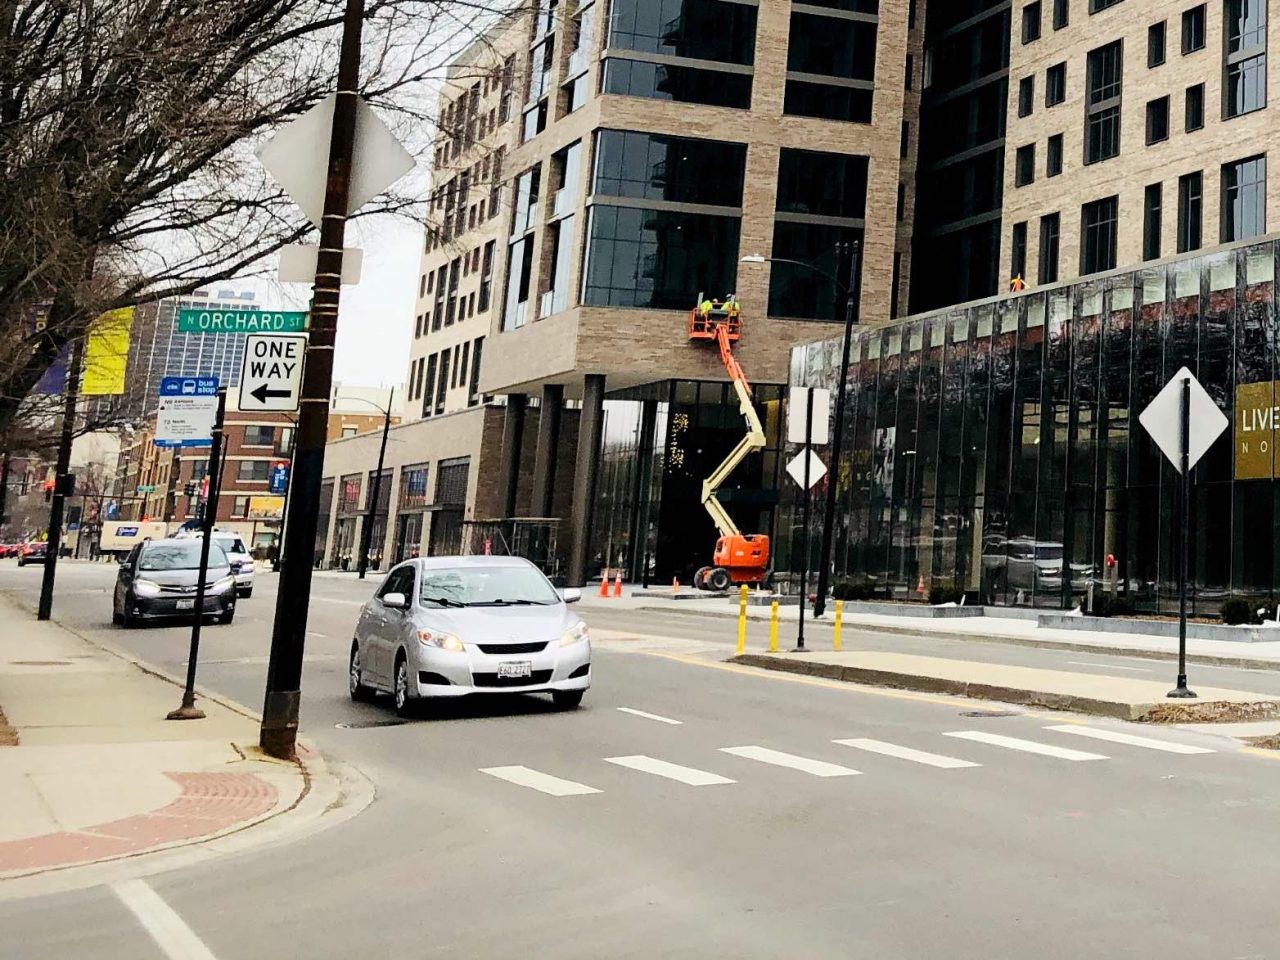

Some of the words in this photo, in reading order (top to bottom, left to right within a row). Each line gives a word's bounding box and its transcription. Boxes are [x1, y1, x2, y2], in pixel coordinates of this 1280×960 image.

[187, 315, 194, 325] N
[199, 312, 285, 330] ORCHARD
[289, 317, 300, 327] ST
[254, 340, 297, 359] ONE
[251, 361, 297, 379] WAY
[197, 386, 216, 395] stop
[198, 379, 214, 387] bus
